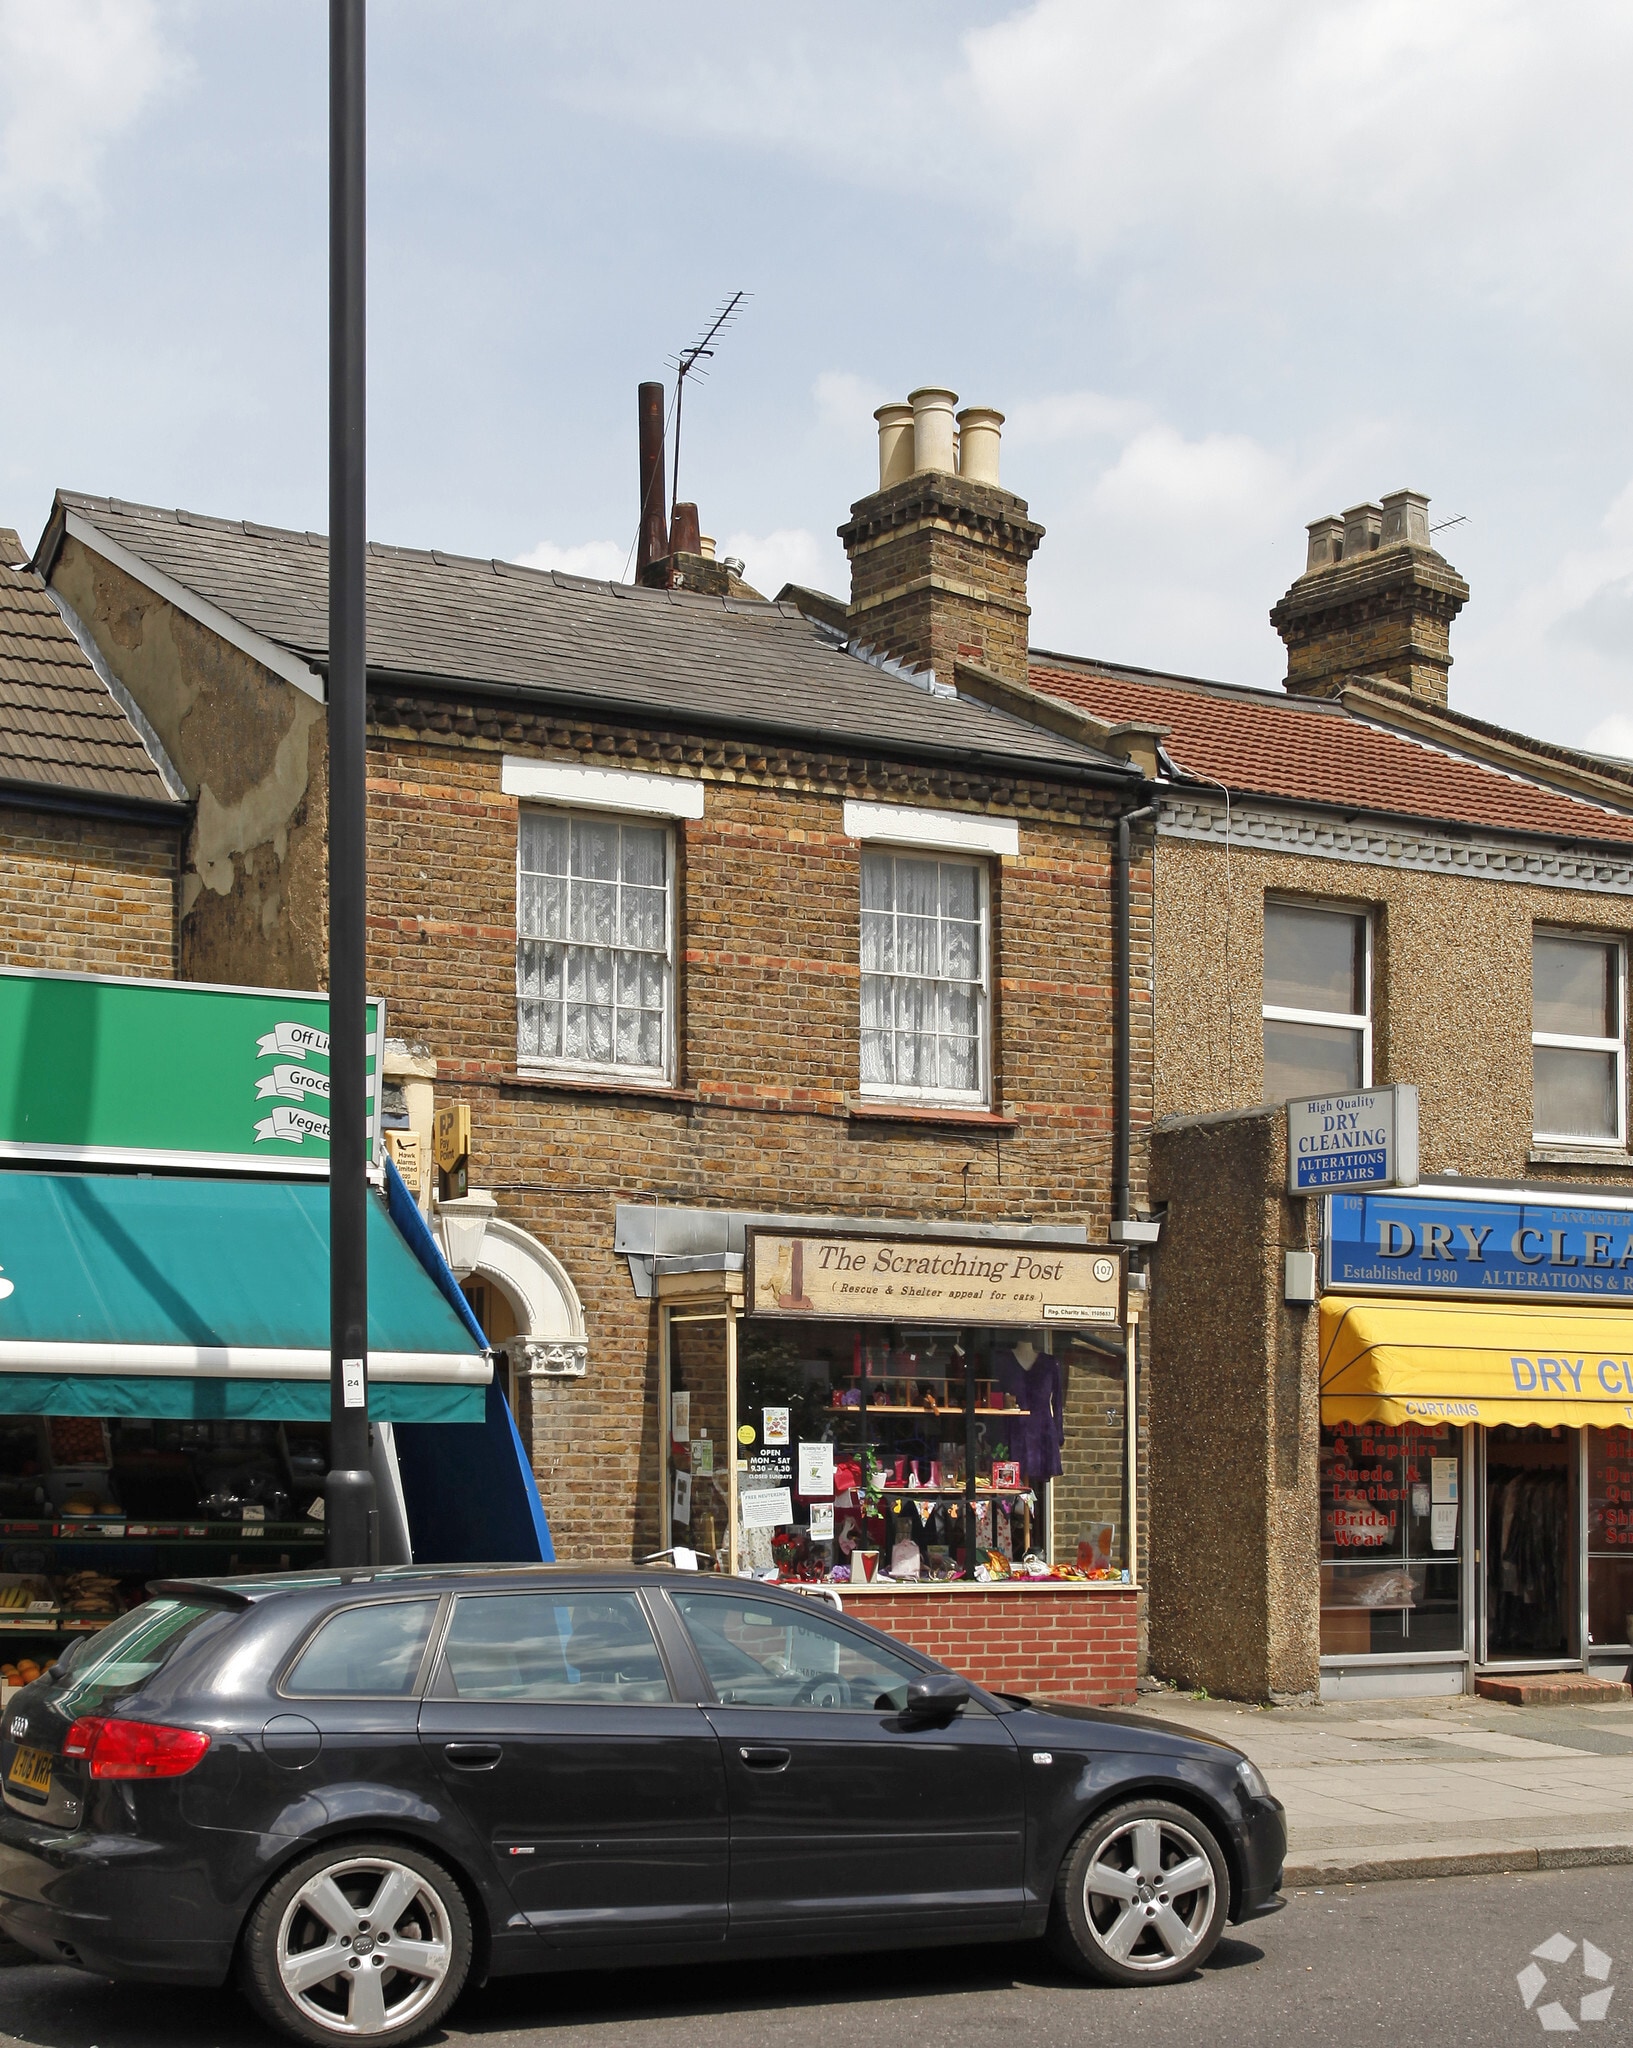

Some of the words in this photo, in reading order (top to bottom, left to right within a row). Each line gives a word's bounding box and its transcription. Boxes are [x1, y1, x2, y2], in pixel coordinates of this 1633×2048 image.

[291, 1029, 314, 1045] Off
[290, 1071, 330, 1092] Groce
[1308, 1100, 1332, 1114] High
[1336, 1096, 1375, 1111] Quality
[1323, 1112, 1359, 1132] DRY
[440, 1138, 449, 1150] Pay
[1299, 1128, 1386, 1153] CLEANING
[398, 1151, 416, 1159] Hawk
[440, 1148, 454, 1161] Point
[1300, 1152, 1384, 1171] ALTERATIONS
[1308, 1173, 1316, 1184] &
[1321, 1167, 1374, 1182] REPAIRS
[1343, 1197, 1363, 1211] 105
[1552, 1211, 1631, 1226] LANCASTER
[1376, 1219, 1493, 1262] DRY
[818, 1246, 866, 1271] The
[873, 1248, 1008, 1283] Scratching
[1011, 1256, 1063, 1281] Post
[1096, 1265, 1111, 1275] 107
[1343, 1264, 1421, 1281] Established
[1427, 1268, 1458, 1283] 1980
[1482, 1270, 1603, 1289] ALTERATIONS
[1606, 1276, 1619, 1290] &
[885, 1285, 894, 1295] &
[901, 1286, 942, 1297] Shelter
[948, 1290, 983, 1299] appeal
[990, 1290, 1006, 1300] for
[1510, 1357, 1584, 1393] DRY
[1406, 1401, 1480, 1417] CURTAINS
[1333, 1421, 1443, 1437] Alterations
[1333, 1438, 1349, 1456] &
[1361, 1439, 1437, 1459] Repairs
[1334, 1463, 1393, 1481] Suede
[1406, 1464, 1420, 1482] &
[1606, 1466, 1633, 1483] Du
[1333, 1484, 1408, 1501] Leather
[1334, 1510, 1396, 1527] Bridal
[1334, 1530, 1384, 1547] Wear
